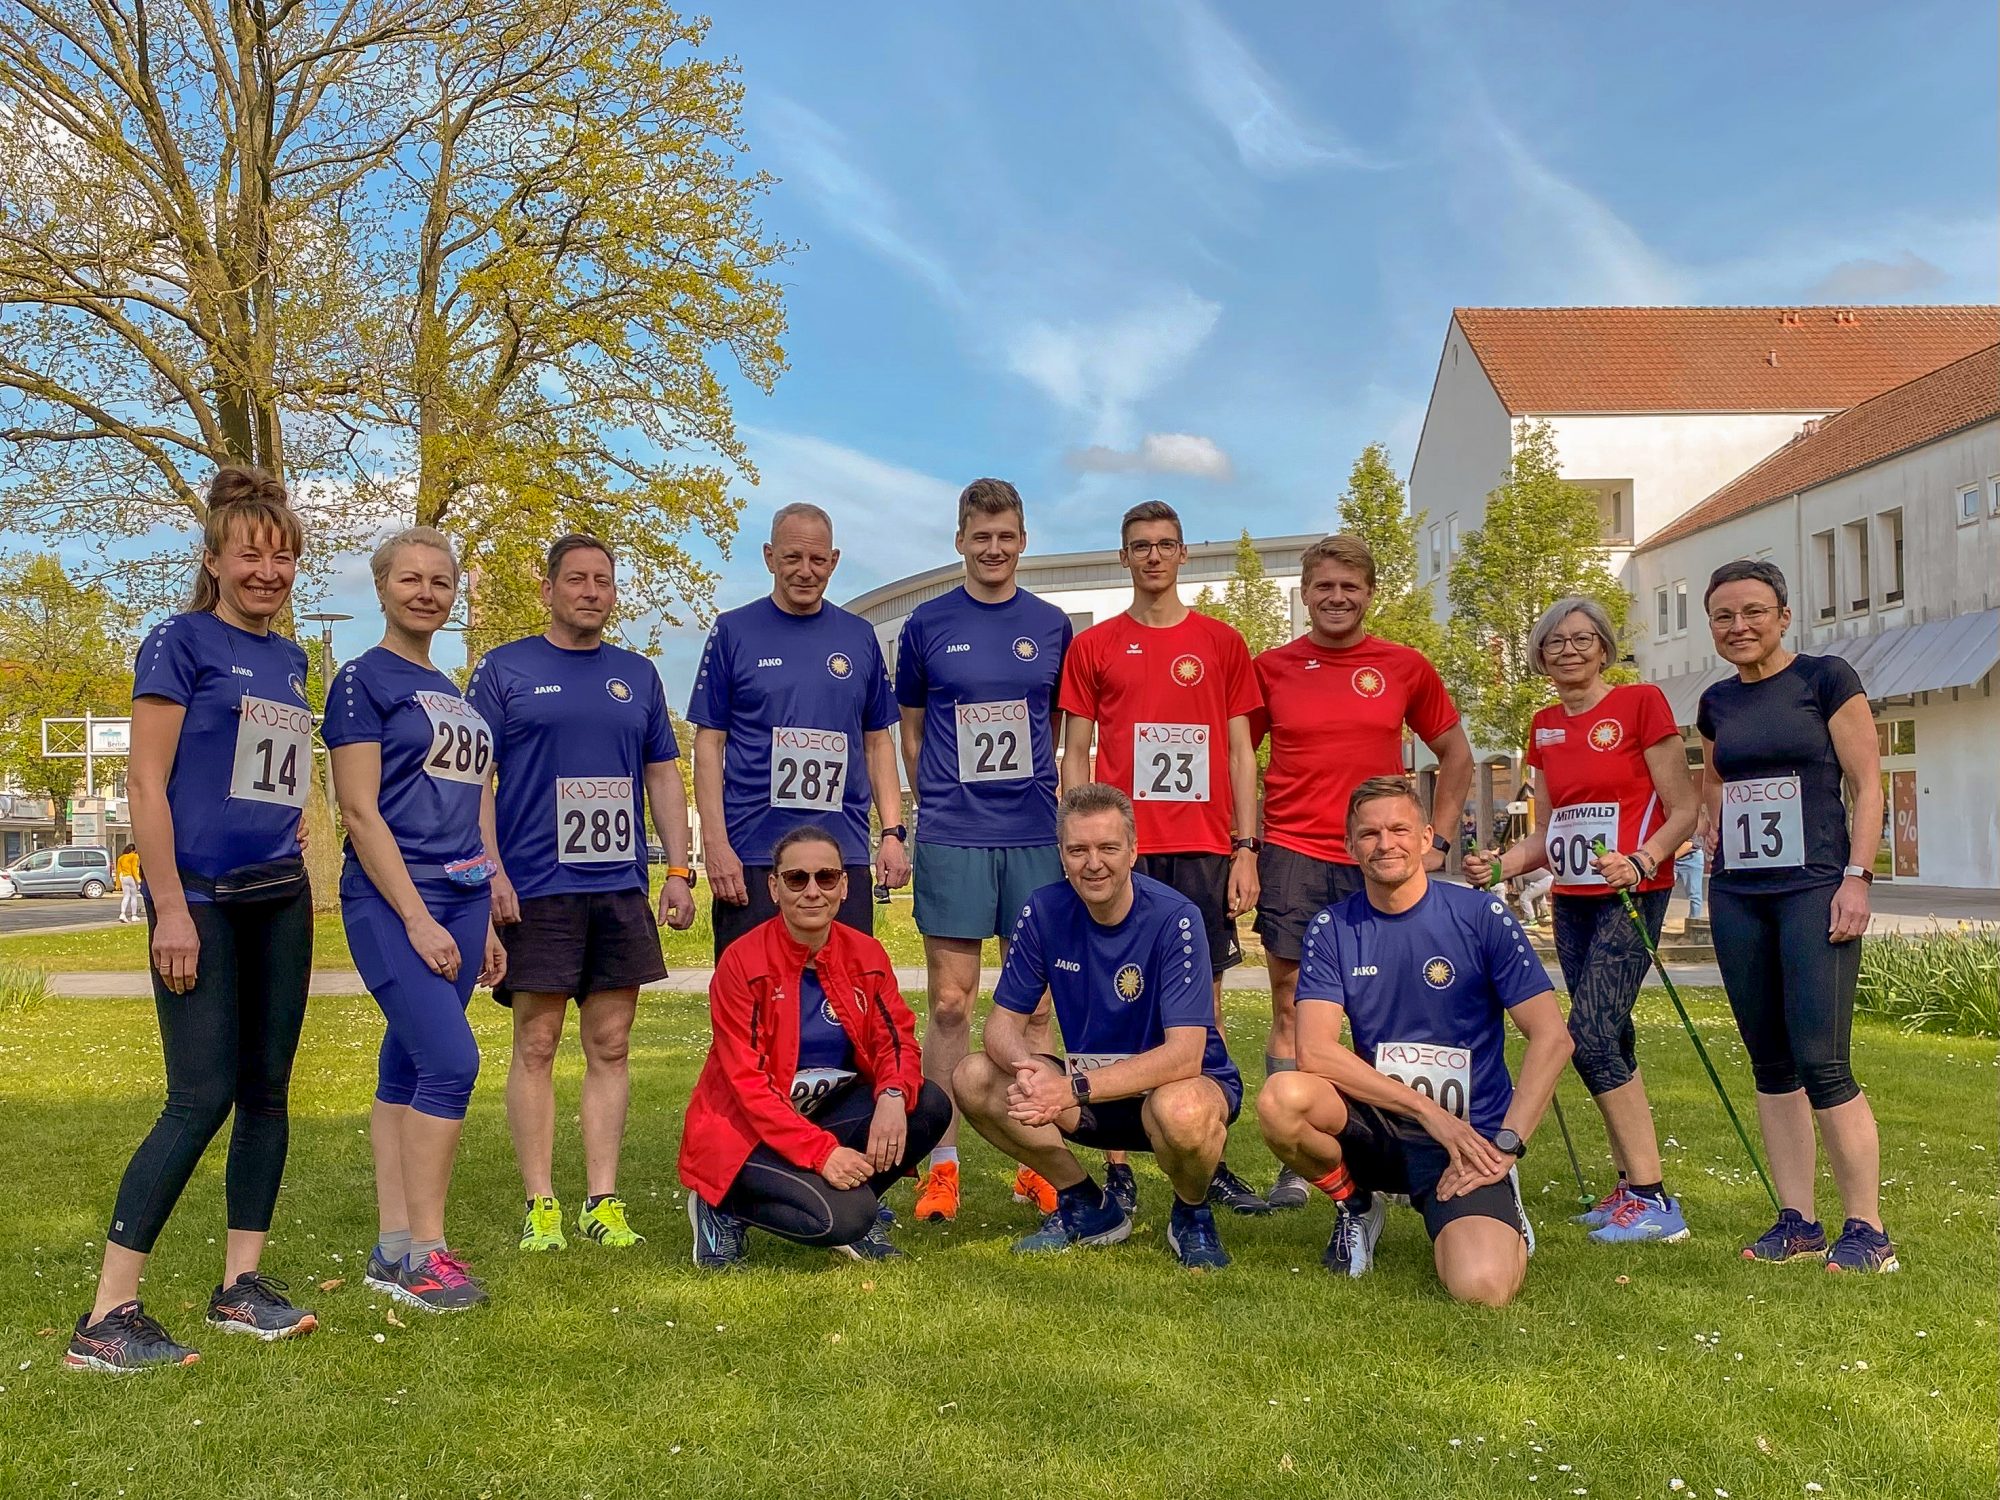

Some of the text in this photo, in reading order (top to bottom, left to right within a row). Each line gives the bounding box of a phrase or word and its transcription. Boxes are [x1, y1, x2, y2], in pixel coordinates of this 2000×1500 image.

[944, 644, 970, 653] JAKO
[231, 666, 253, 677] JAKO
[758, 658, 783, 667] JAKO
[534, 685, 562, 694] JAKO
[245, 701, 309, 734] KADECO
[422, 695, 481, 719] KADECO
[959, 704, 1026, 725] KADECO
[776, 732, 846, 753] KADECO
[1139, 727, 1206, 744] KADECO
[430, 721, 489, 775] 286
[975, 730, 1018, 773] 22
[253, 738, 297, 796] 14
[1151, 752, 1193, 793] 23
[561, 782, 630, 799] KADECO
[776, 758, 843, 803] 287
[1727, 782, 1797, 804] KADECO
[564, 809, 631, 854] 289
[1737, 811, 1783, 859] 13
[1898, 810, 1917, 842] %
[1055, 959, 1080, 972] JAKO
[1352, 966, 1378, 977] JAKO
[1382, 1046, 1467, 1069] KADECO
